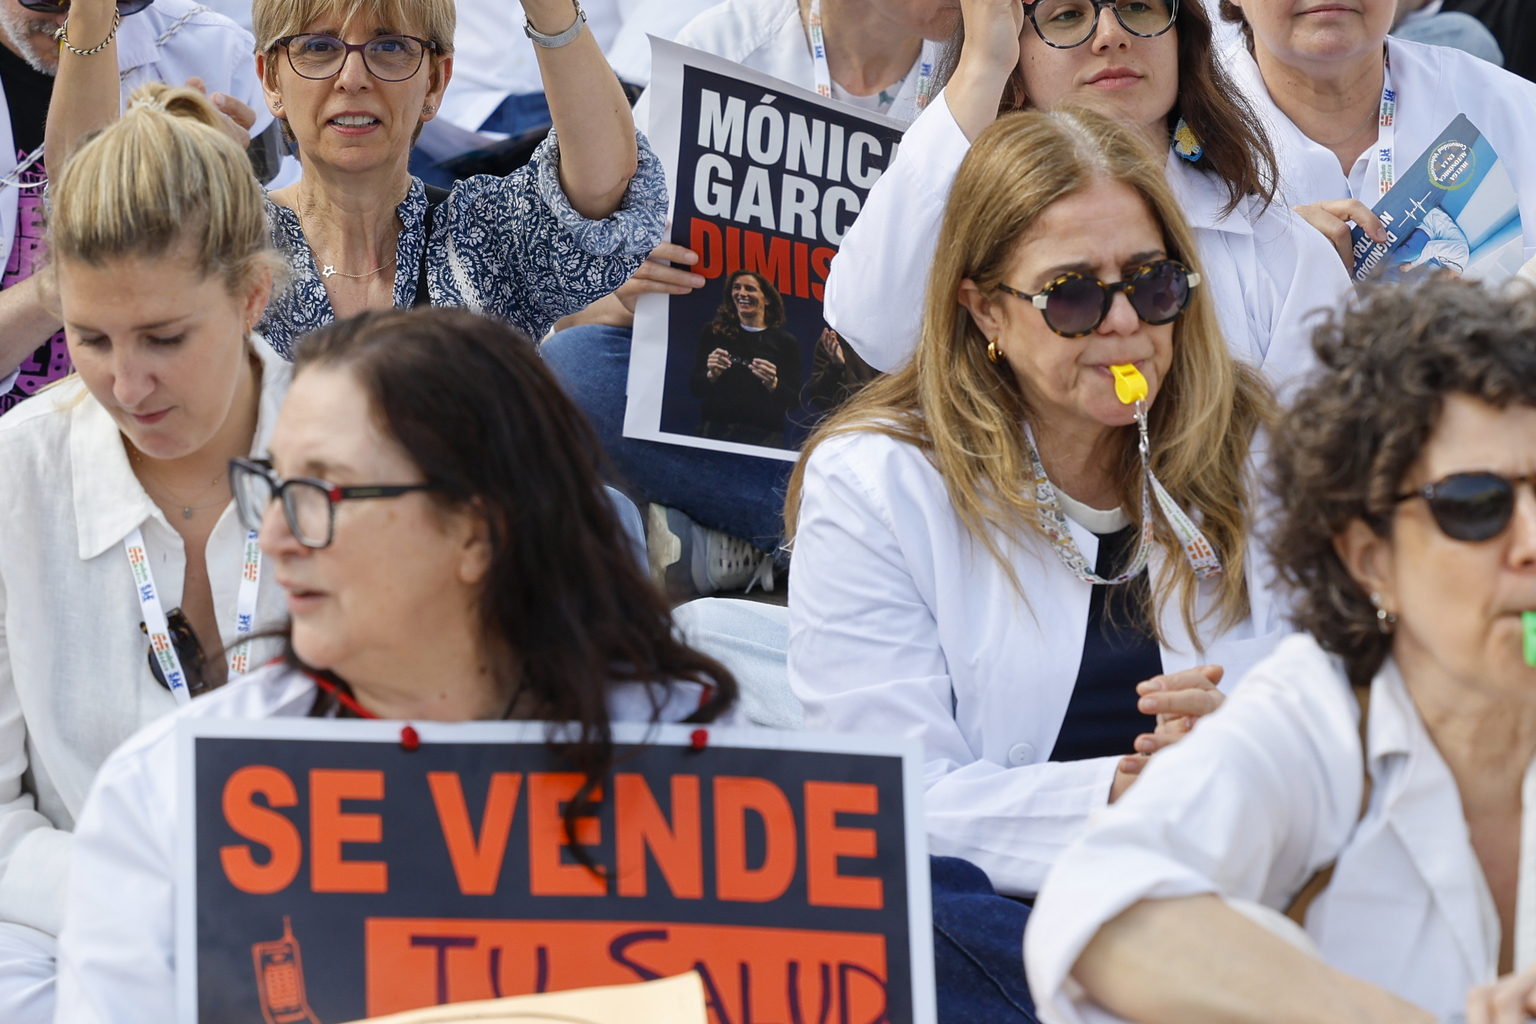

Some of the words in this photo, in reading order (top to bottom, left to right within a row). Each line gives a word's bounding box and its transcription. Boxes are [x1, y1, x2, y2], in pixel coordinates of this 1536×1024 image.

[697, 88, 899, 190] MÓNIC
[220, 764, 388, 895] SE
[427, 771, 884, 910] VENDE
